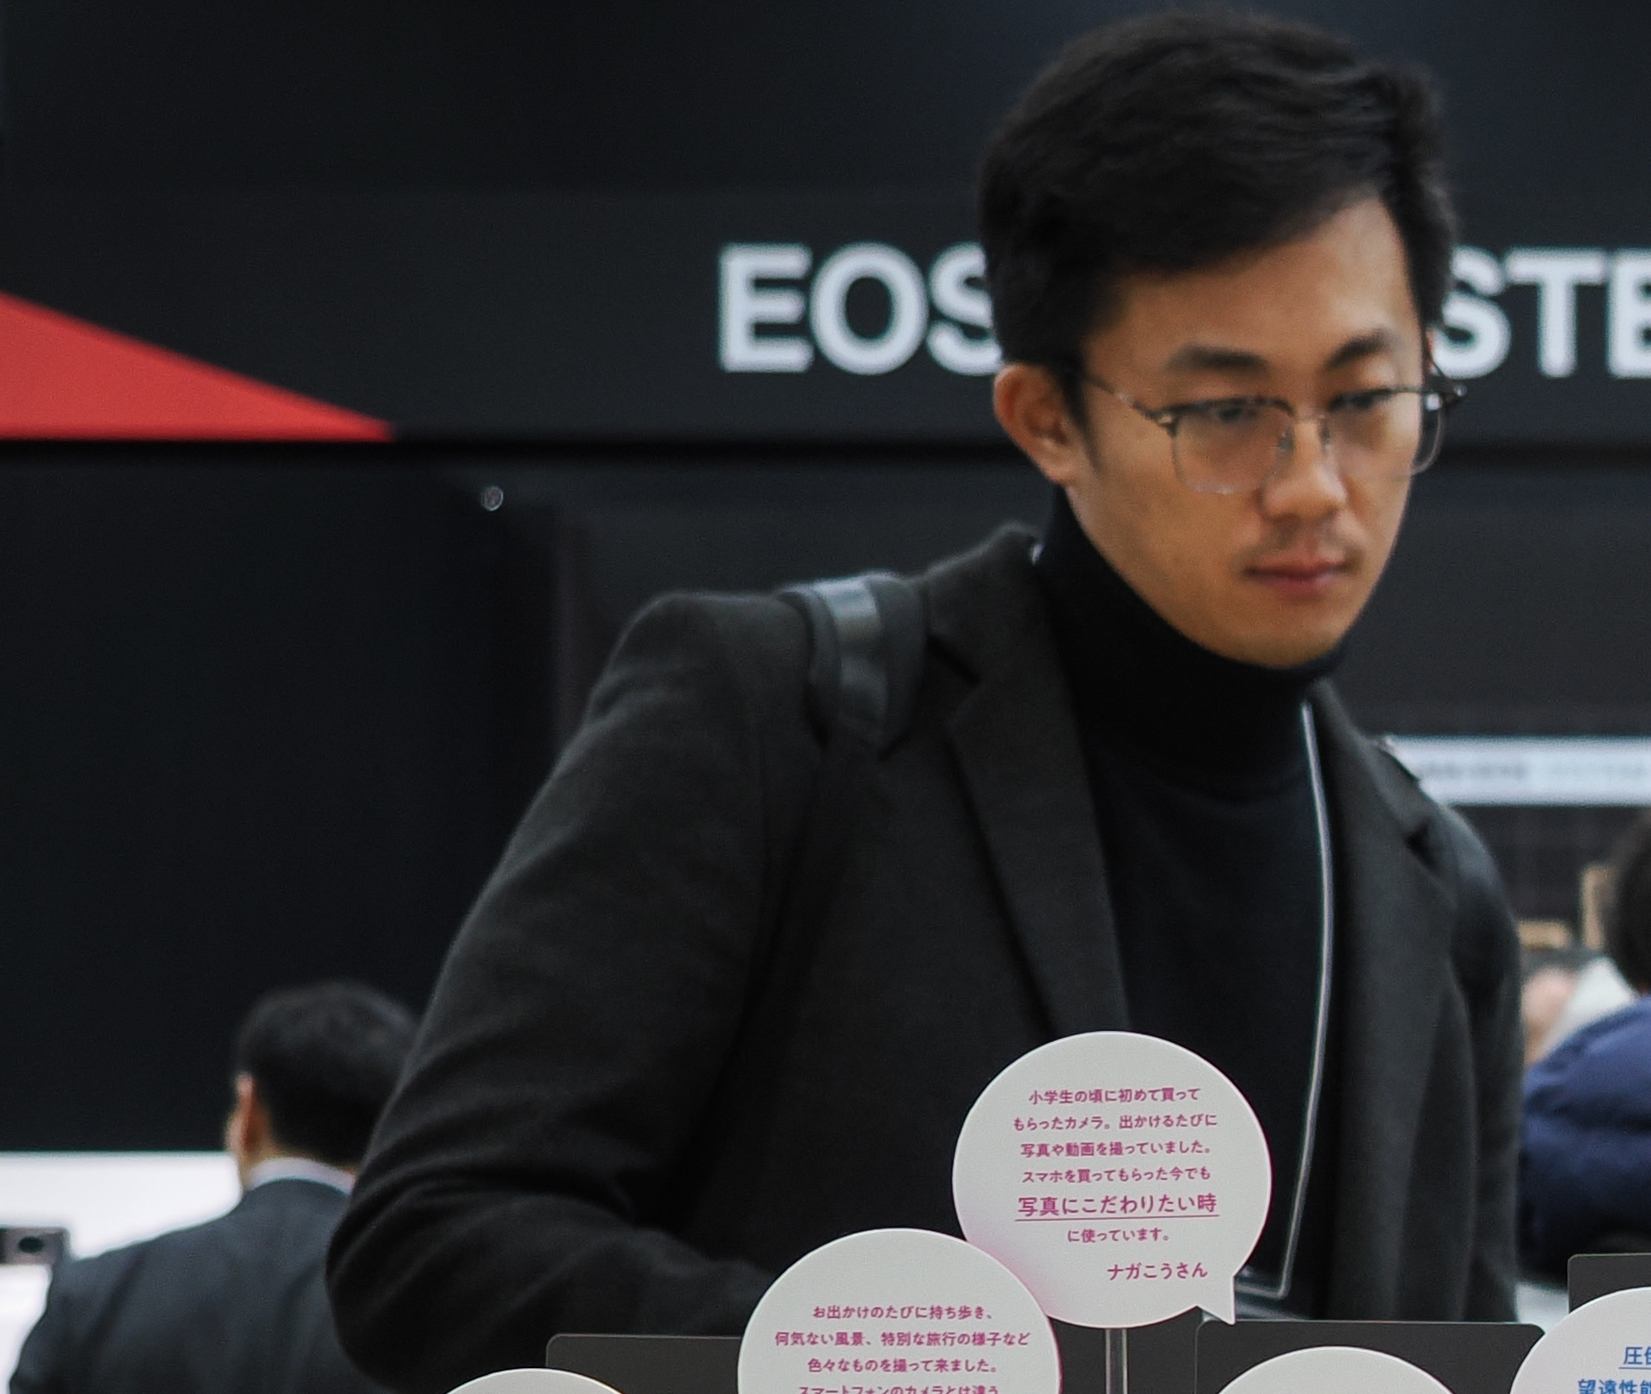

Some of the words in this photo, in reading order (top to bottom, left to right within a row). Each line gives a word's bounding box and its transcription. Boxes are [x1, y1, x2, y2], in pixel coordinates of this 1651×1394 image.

[719, 241, 1002, 375] EOS
[1018, 1193, 1219, 1217] 写真にこだわりたい時
[1068, 1228, 1168, 1243] に使っています。
[1107, 1263, 1207, 1280] ナガこうさん
